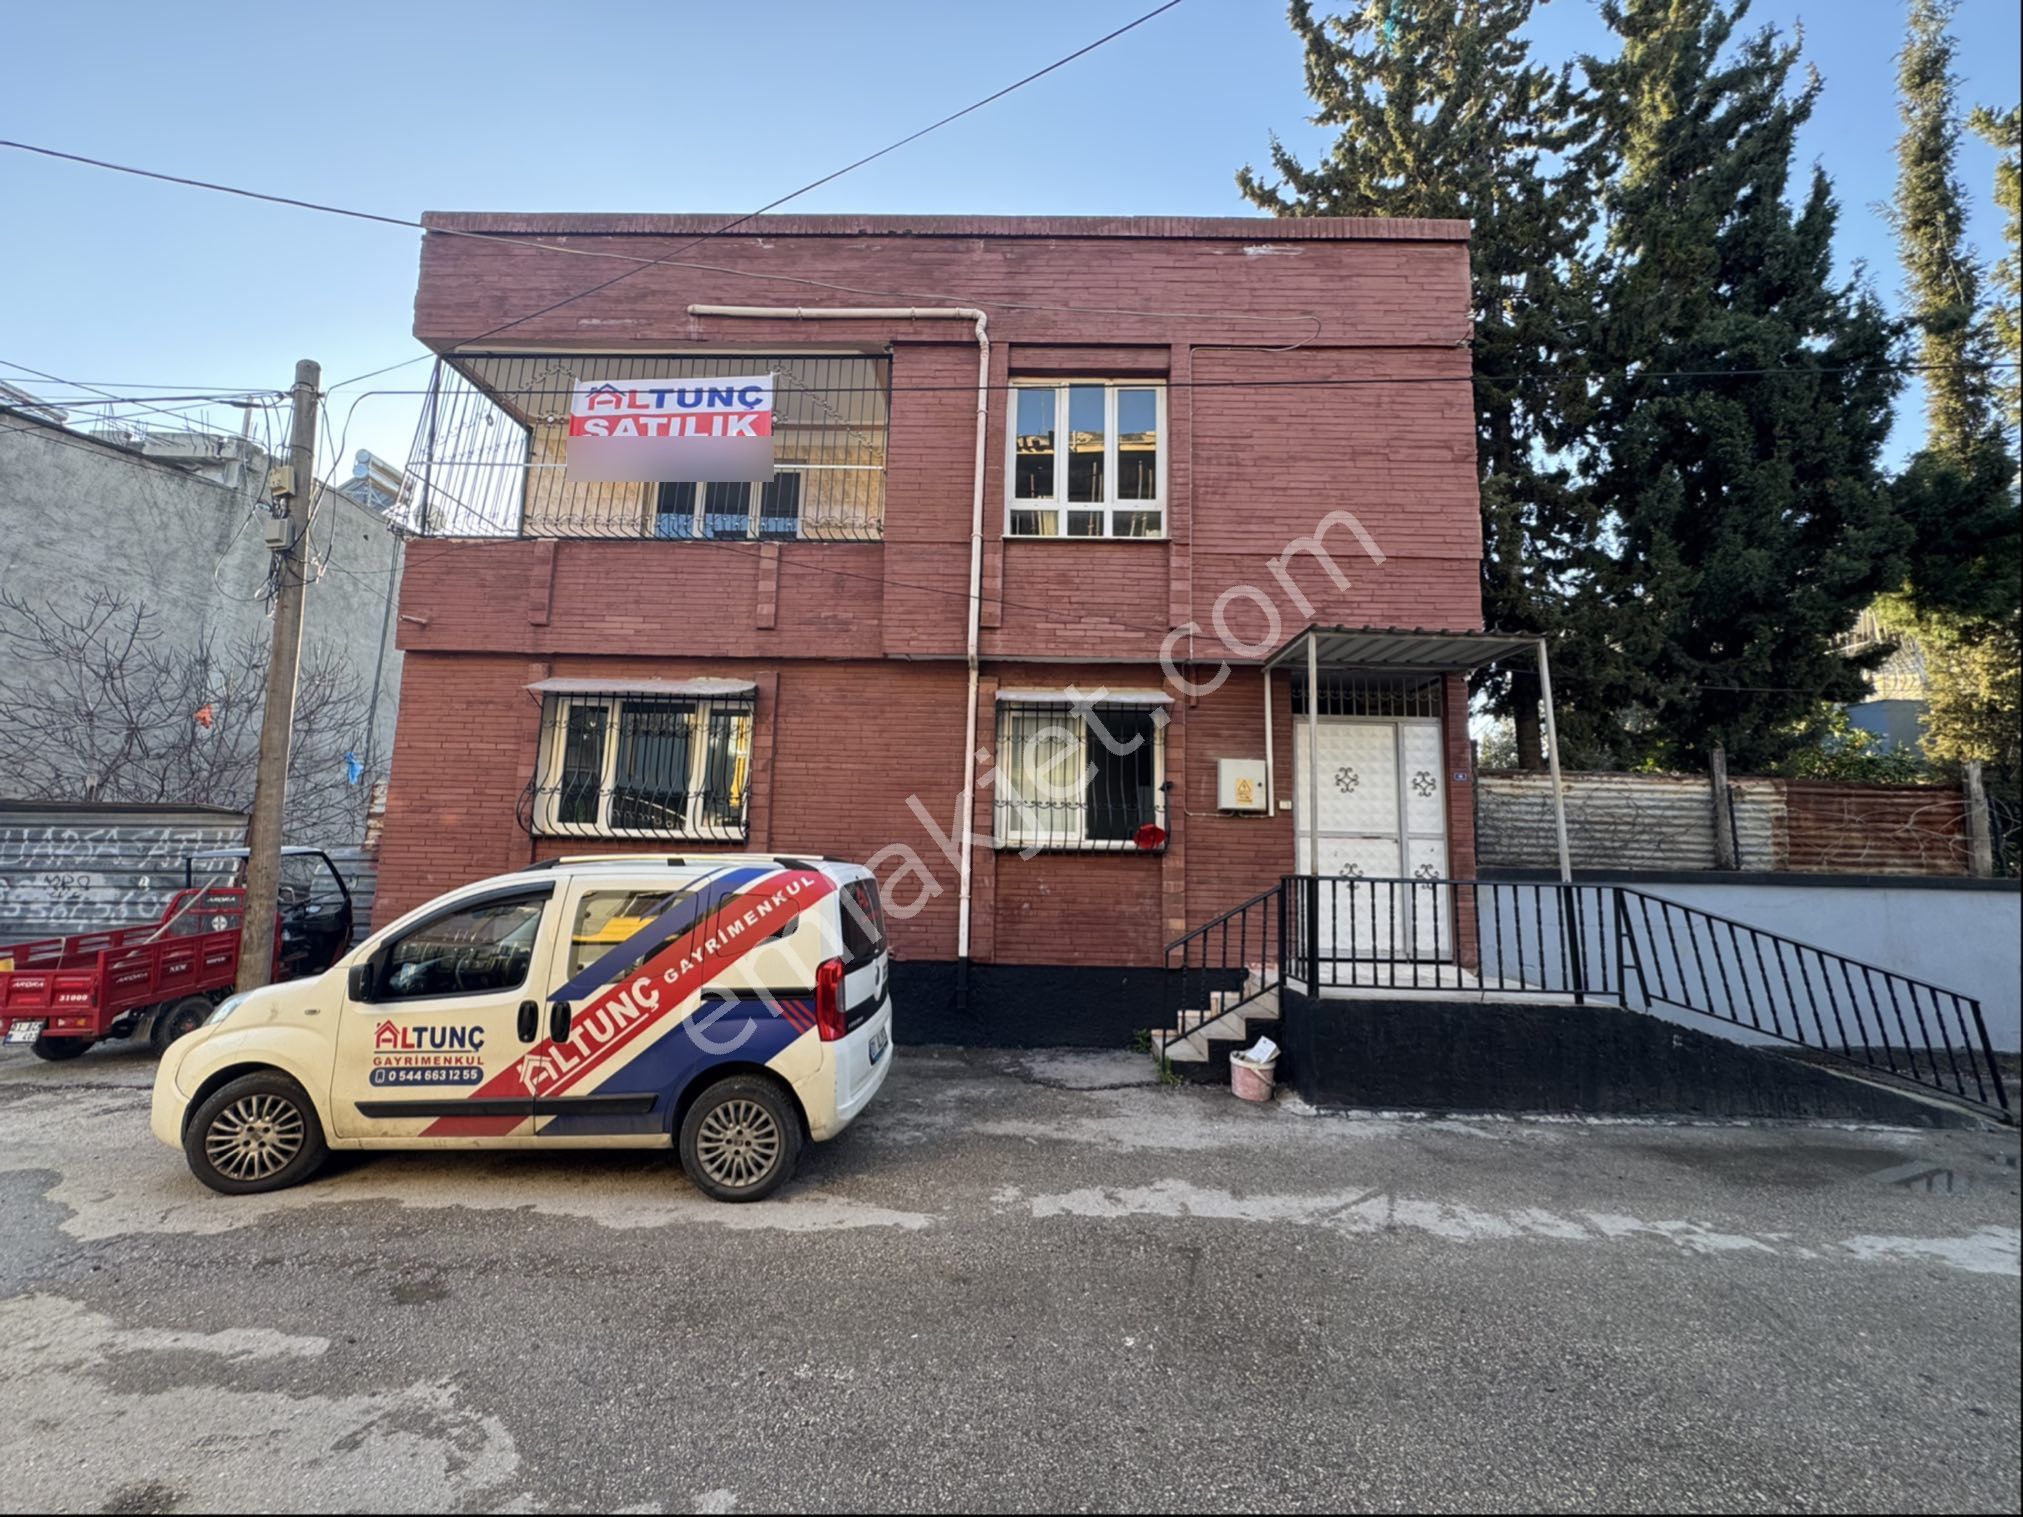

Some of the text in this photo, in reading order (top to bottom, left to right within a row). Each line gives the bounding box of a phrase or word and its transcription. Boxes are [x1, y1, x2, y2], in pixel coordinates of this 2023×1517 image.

[586, 384, 763, 410] ALTUNÇ
[584, 414, 759, 436] SATILIK
[664, 876, 815, 984] GAYRİMENKUL
[375, 1020, 485, 1052] ALTUNÇ
[517, 976, 660, 1096] ALTUNÇ
[373, 1055, 484, 1066] GAYRİMENKUL
[388, 1069, 478, 1081] 0 544 663 12 55
